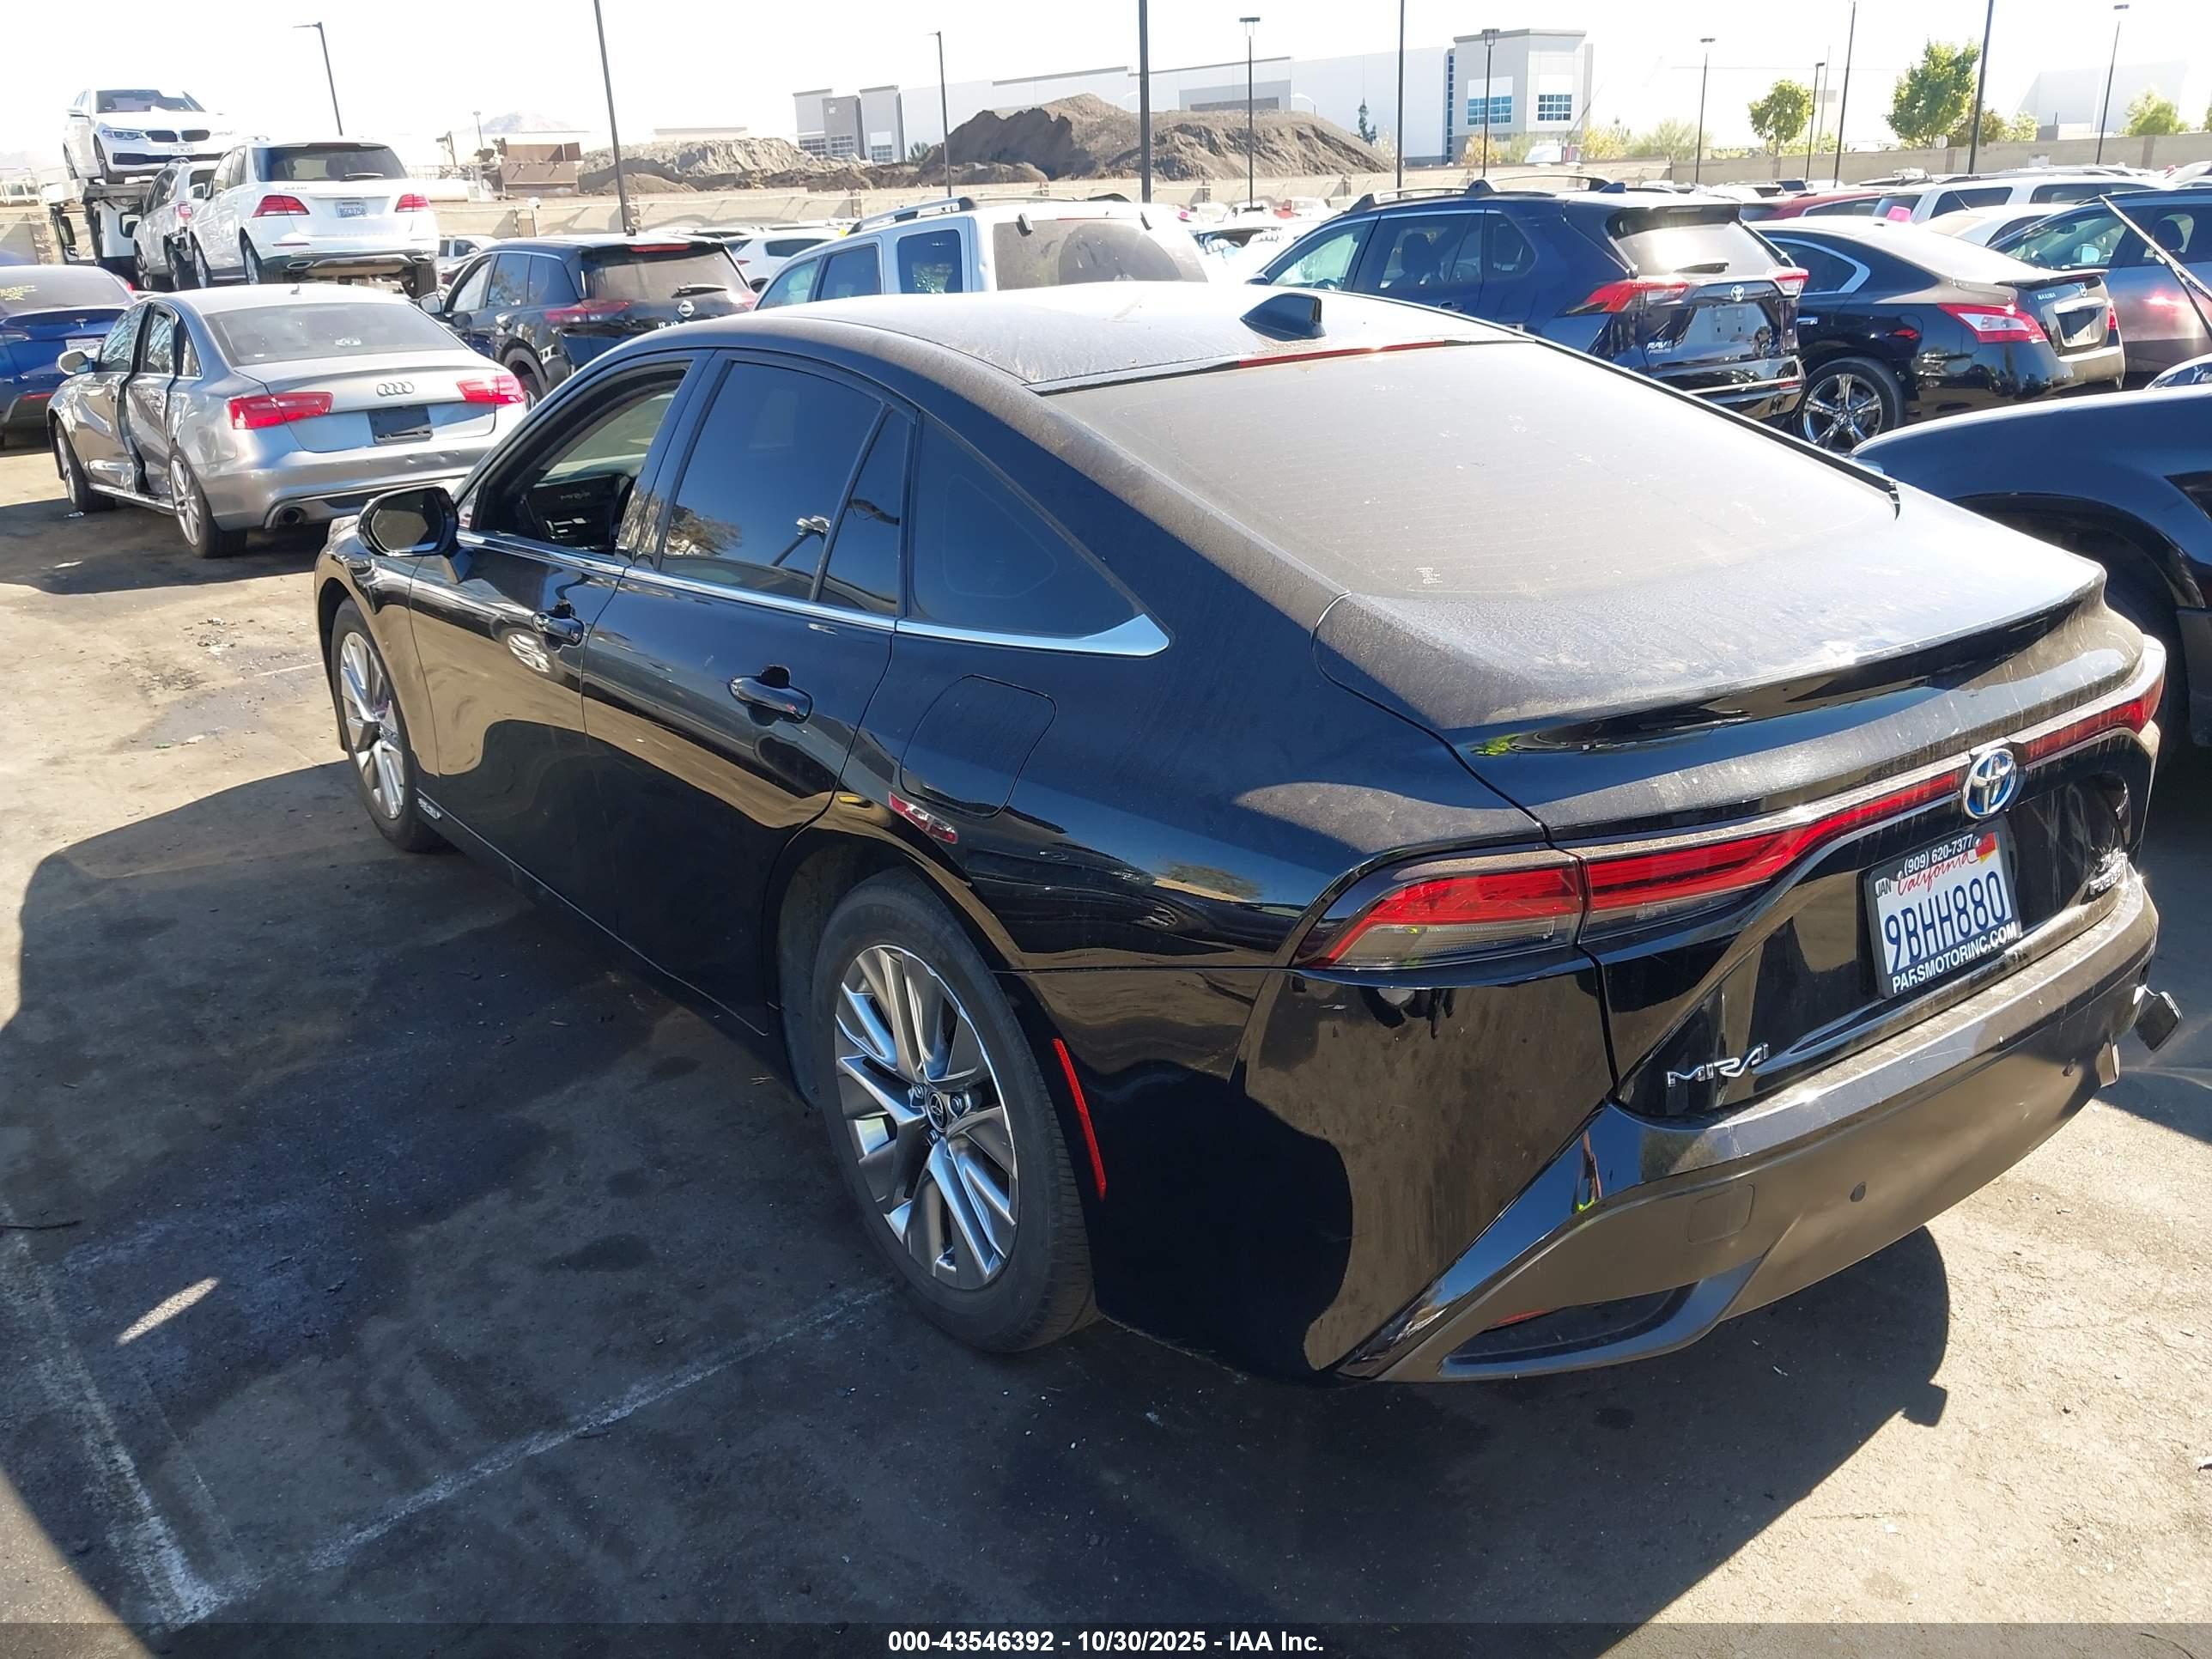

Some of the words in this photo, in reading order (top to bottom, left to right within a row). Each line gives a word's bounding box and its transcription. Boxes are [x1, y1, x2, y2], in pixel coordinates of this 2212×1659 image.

[1897, 852, 1978, 896] California
[1904, 851, 1929, 875] (909)
[1931, 834, 1974, 861] 620-7377
[1875, 878, 1892, 898] JAN
[1885, 871, 2006, 973] 9BHH880
[1892, 921, 2018, 994] PARSMOTORINC.COM
[1667, 1042, 1769, 1087] MIRAI
